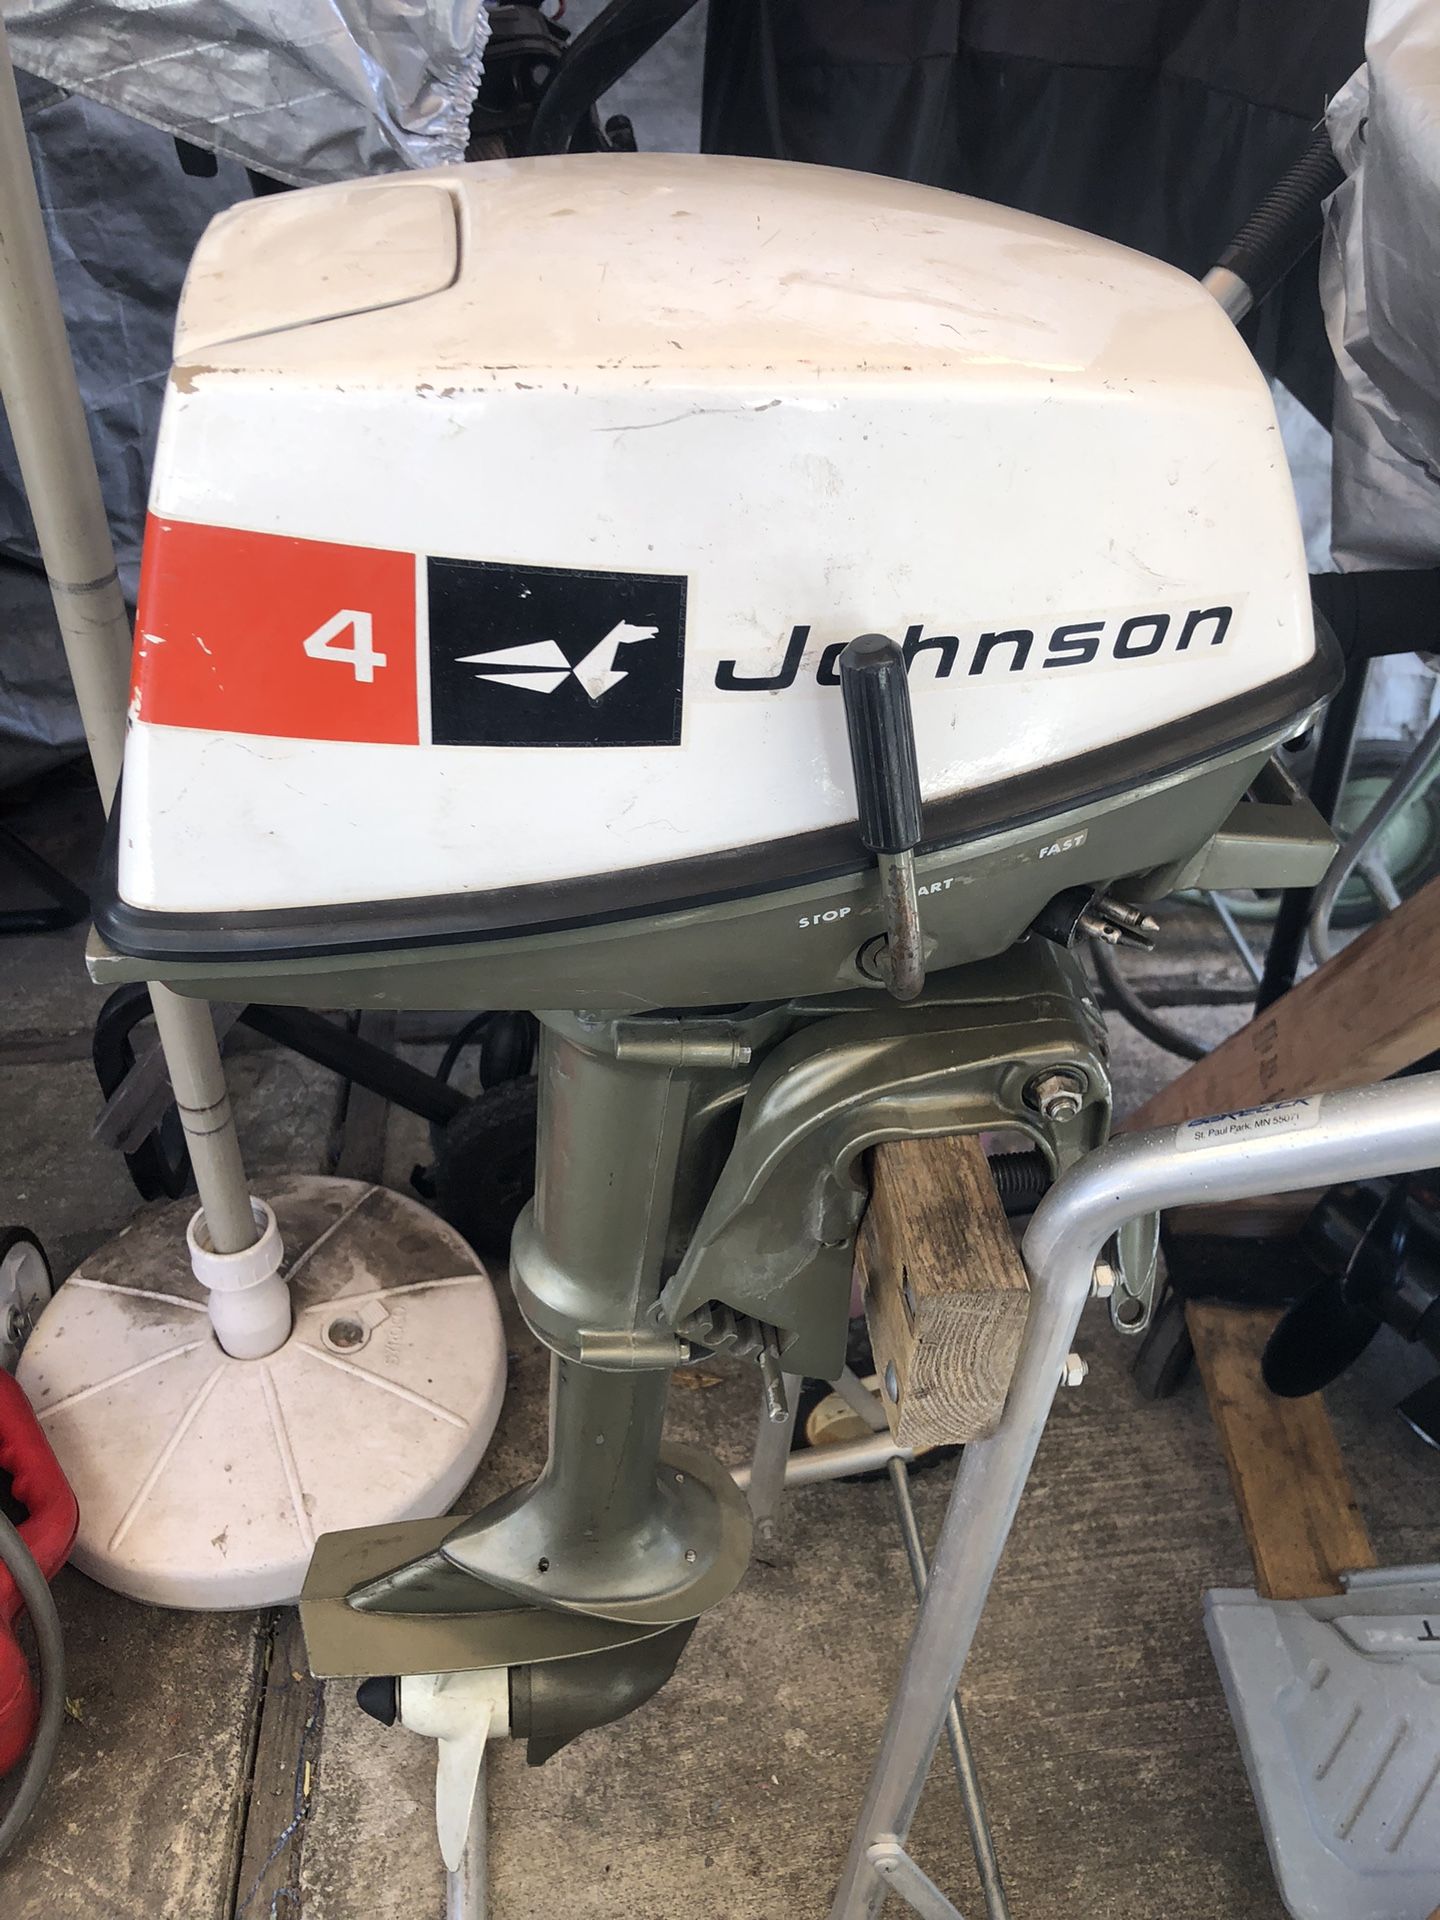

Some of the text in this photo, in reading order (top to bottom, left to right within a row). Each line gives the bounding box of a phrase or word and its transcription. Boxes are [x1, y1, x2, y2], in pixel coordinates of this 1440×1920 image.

[302, 609, 388, 683] 4
[799, 835, 1084, 928] STOP ART FAST
[1208, 1126, 1228, 1137] Paul
[1254, 1118, 1271, 1128] MN
